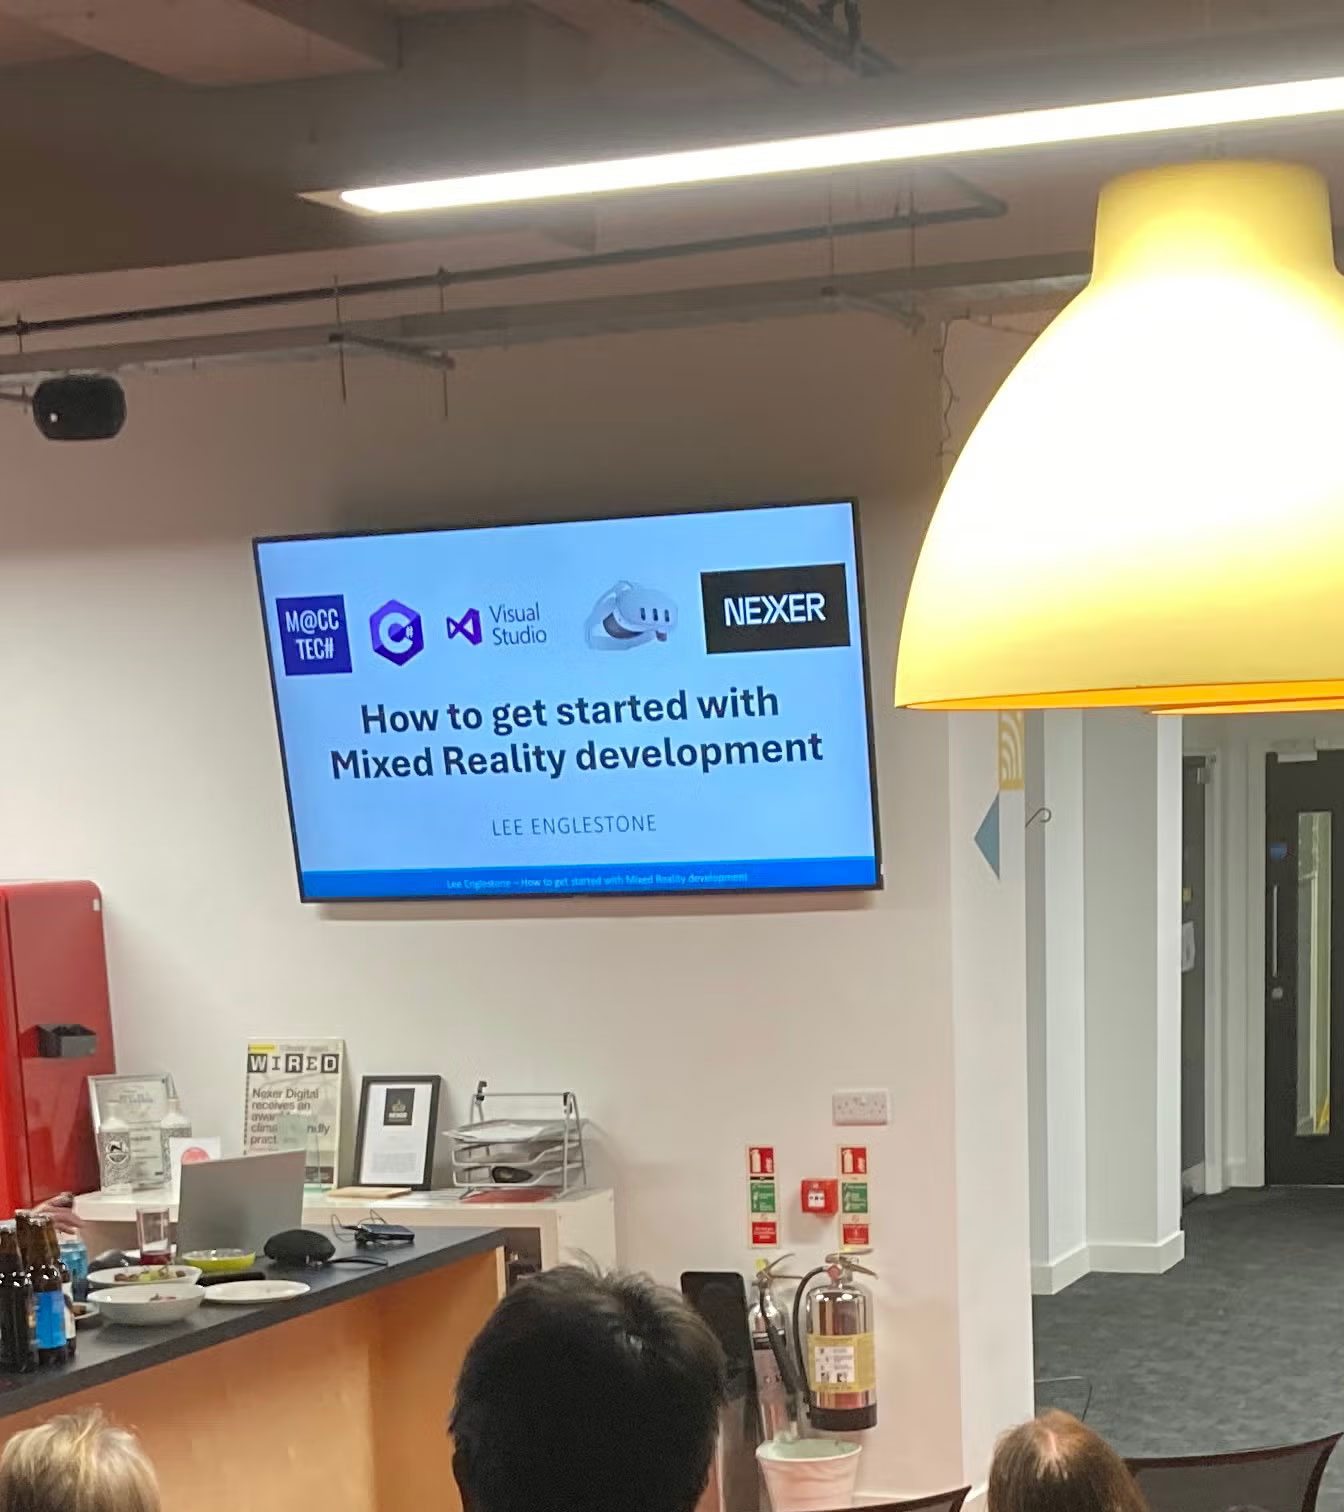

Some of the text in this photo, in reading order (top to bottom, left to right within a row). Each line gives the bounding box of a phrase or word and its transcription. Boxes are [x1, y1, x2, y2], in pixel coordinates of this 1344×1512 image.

[489, 602, 541, 623] Visual
[723, 592, 827, 626] NEXER
[285, 607, 340, 634] M@CC
[493, 625, 548, 645] Studio
[361, 685, 779, 736] How to get started with
[330, 732, 824, 779] Mixed Reality development
[492, 814, 657, 836] LEE ENGLESTONE
[521, 877, 541, 887] How
[543, 877, 552, 887] to
[603, 875, 623, 885] with
[246, 1053, 340, 1074] WIRED
[251, 1101, 311, 1110] receives an
[252, 1088, 319, 1103] Nexer Digital
